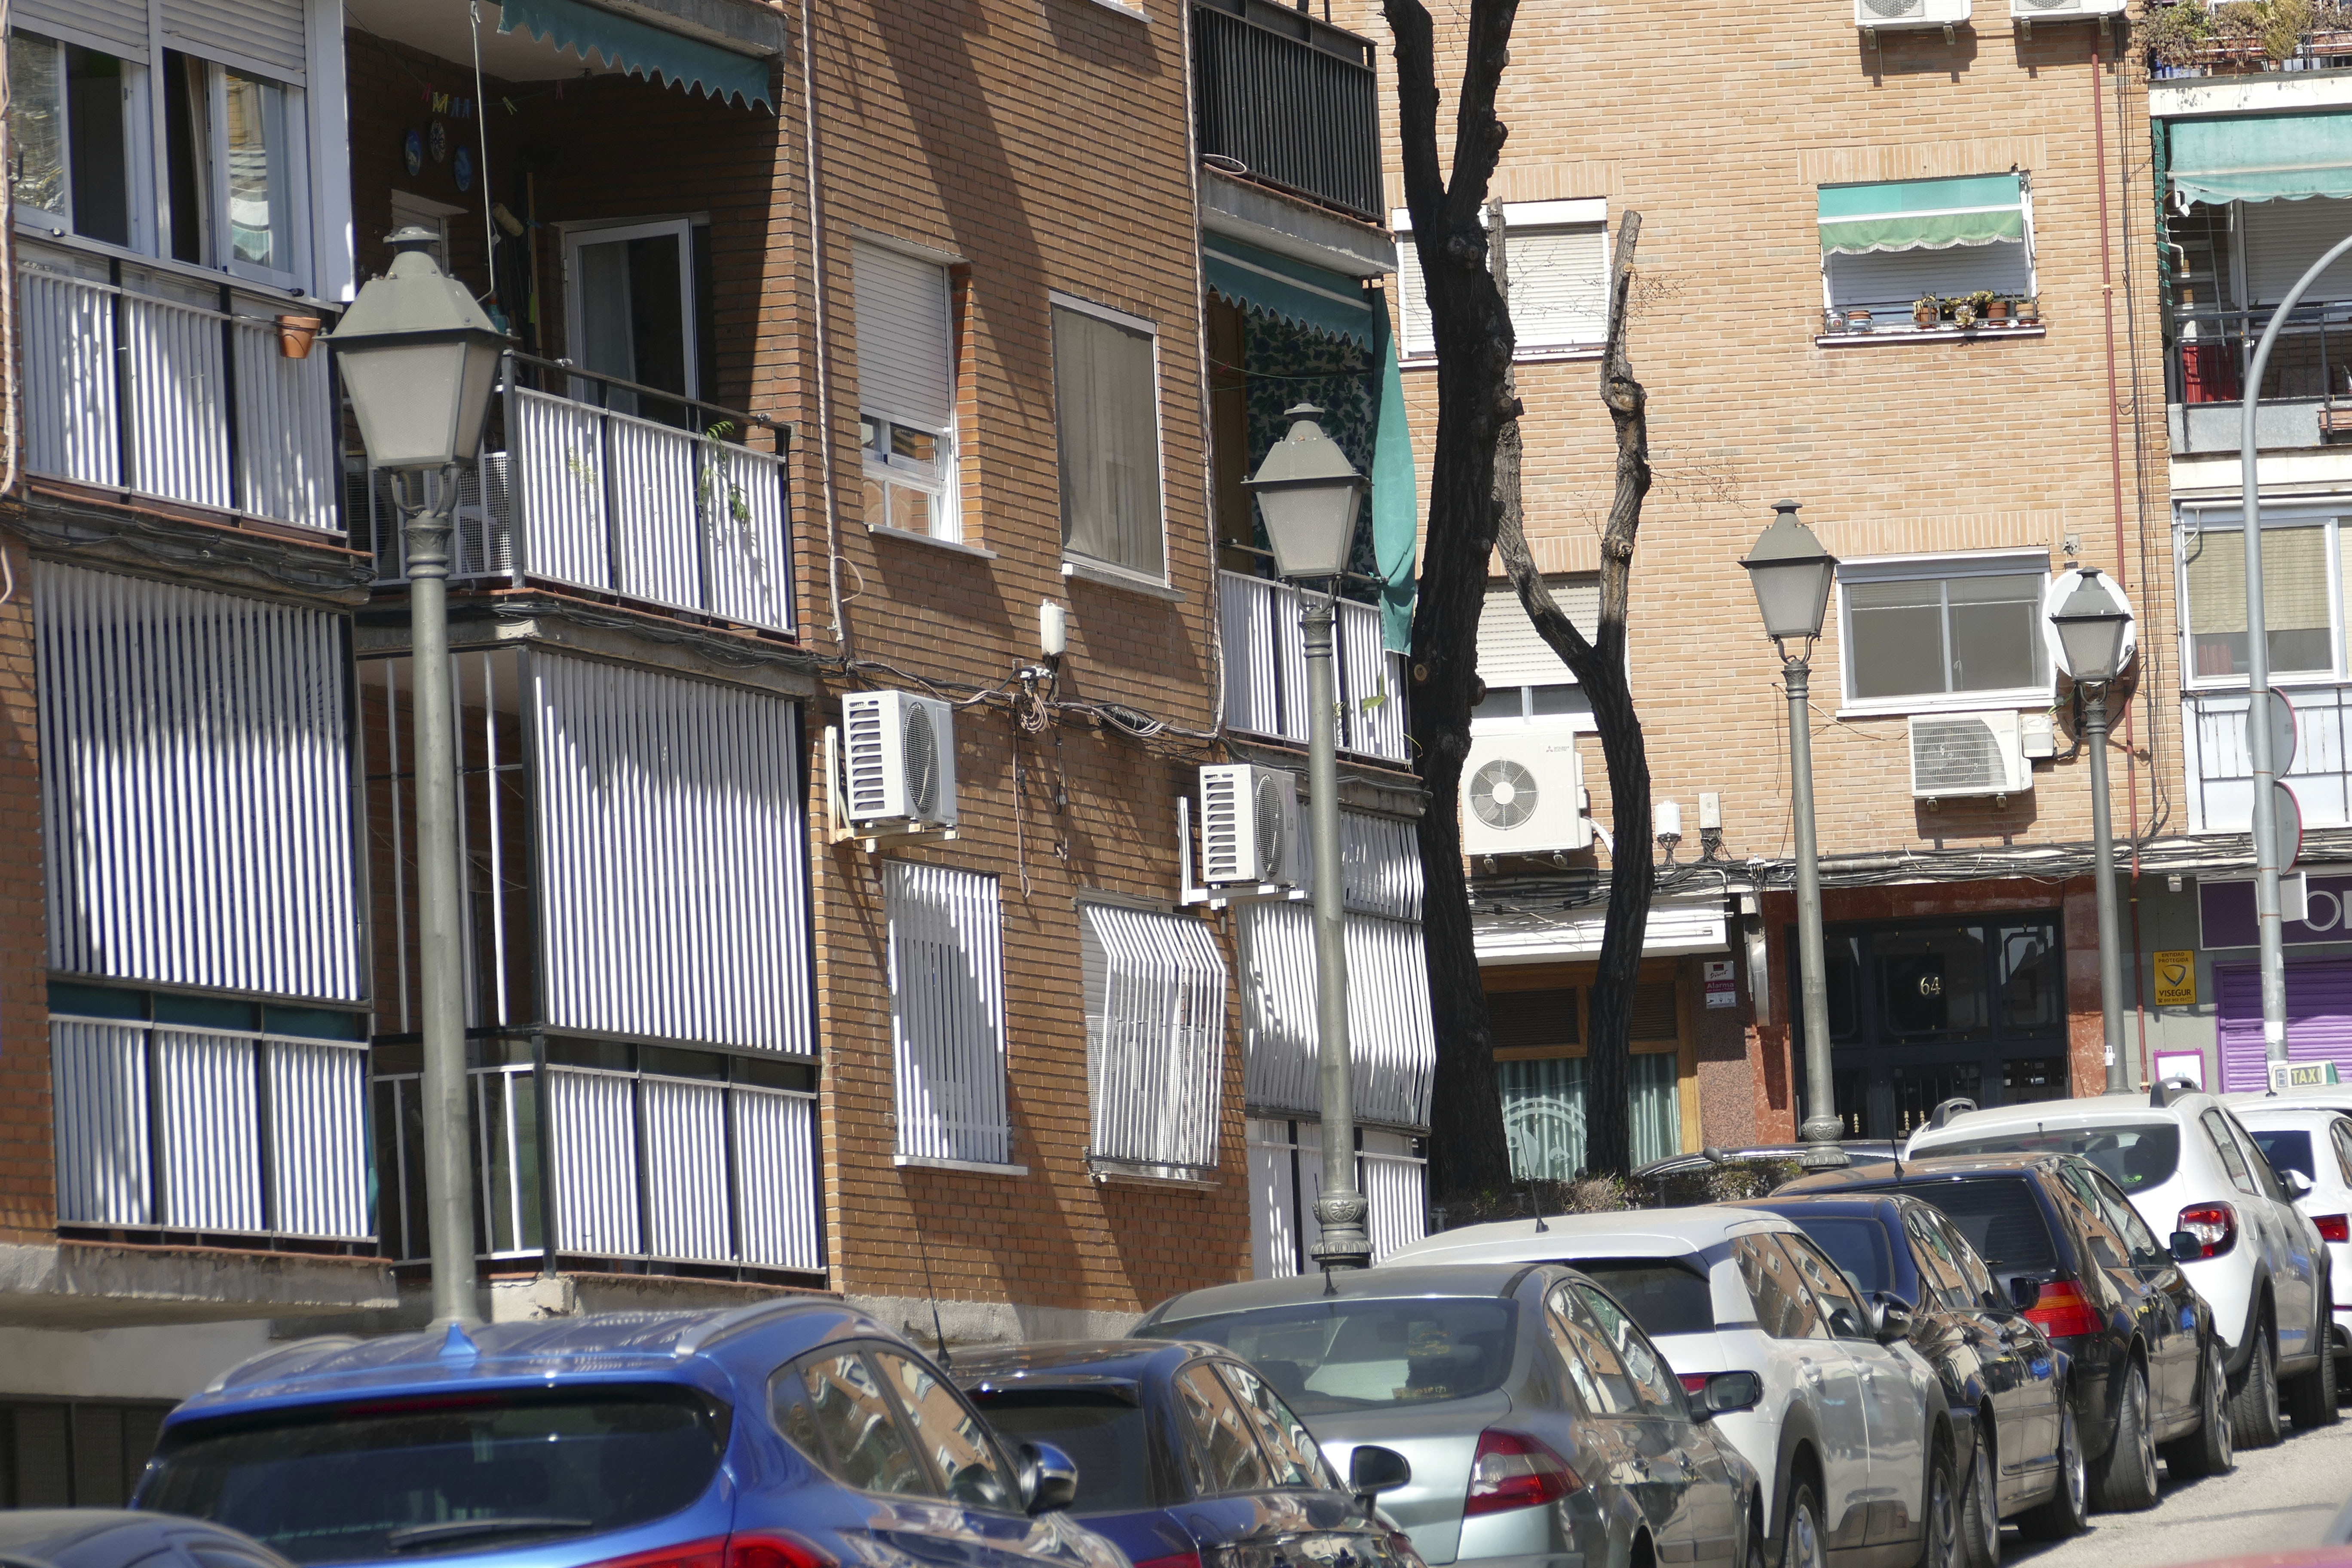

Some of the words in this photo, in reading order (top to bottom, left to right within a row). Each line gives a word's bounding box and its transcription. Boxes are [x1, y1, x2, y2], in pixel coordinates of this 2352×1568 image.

[1920, 977, 1941, 995] 64
[2159, 989, 2191, 997] VISEGUR
[2292, 1068, 2321, 1084] TAXI
